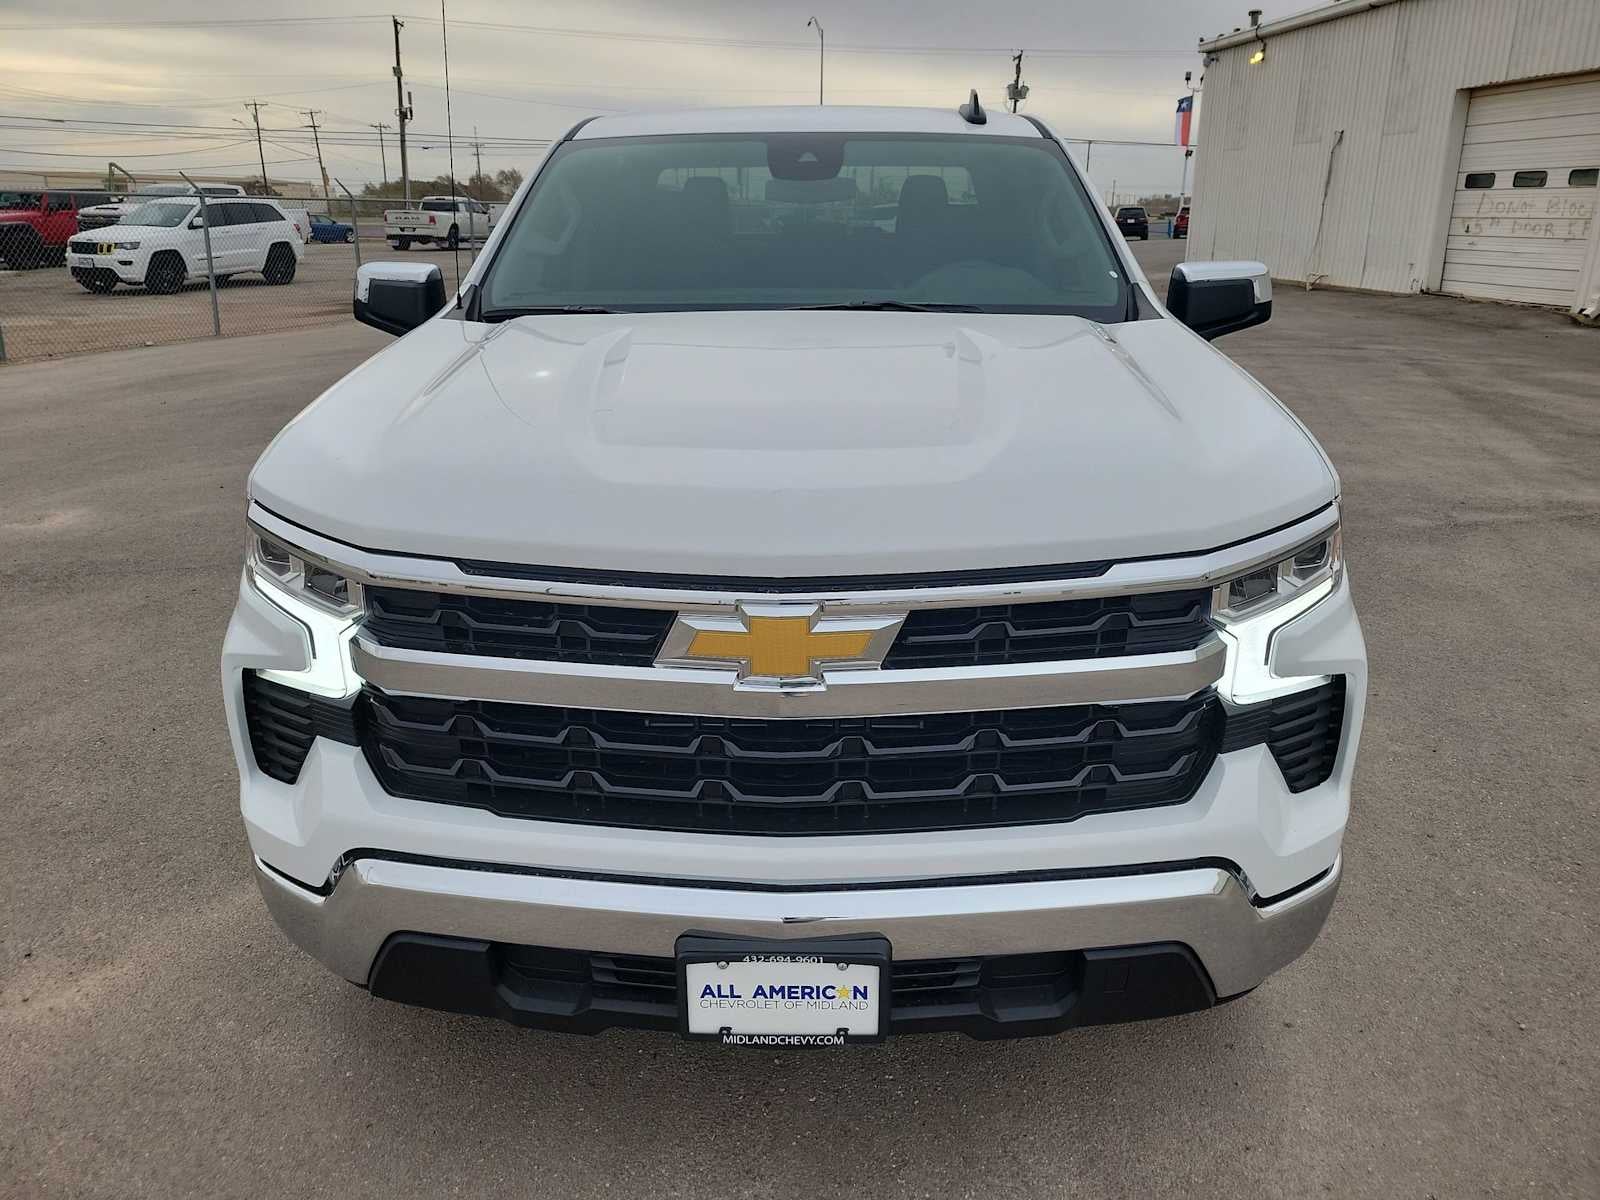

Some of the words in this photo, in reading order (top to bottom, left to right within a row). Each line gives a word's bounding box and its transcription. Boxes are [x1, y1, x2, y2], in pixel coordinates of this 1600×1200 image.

[742, 955, 825, 964] 432-694-9601
[700, 984, 742, 999] ALL
[700, 999, 780, 1010] CHEVROLET
[784, 1000, 804, 1010] OF
[806, 1000, 869, 1011] MIDLAND
[722, 1034, 845, 1046] MIDLANDCHEVY.COM
